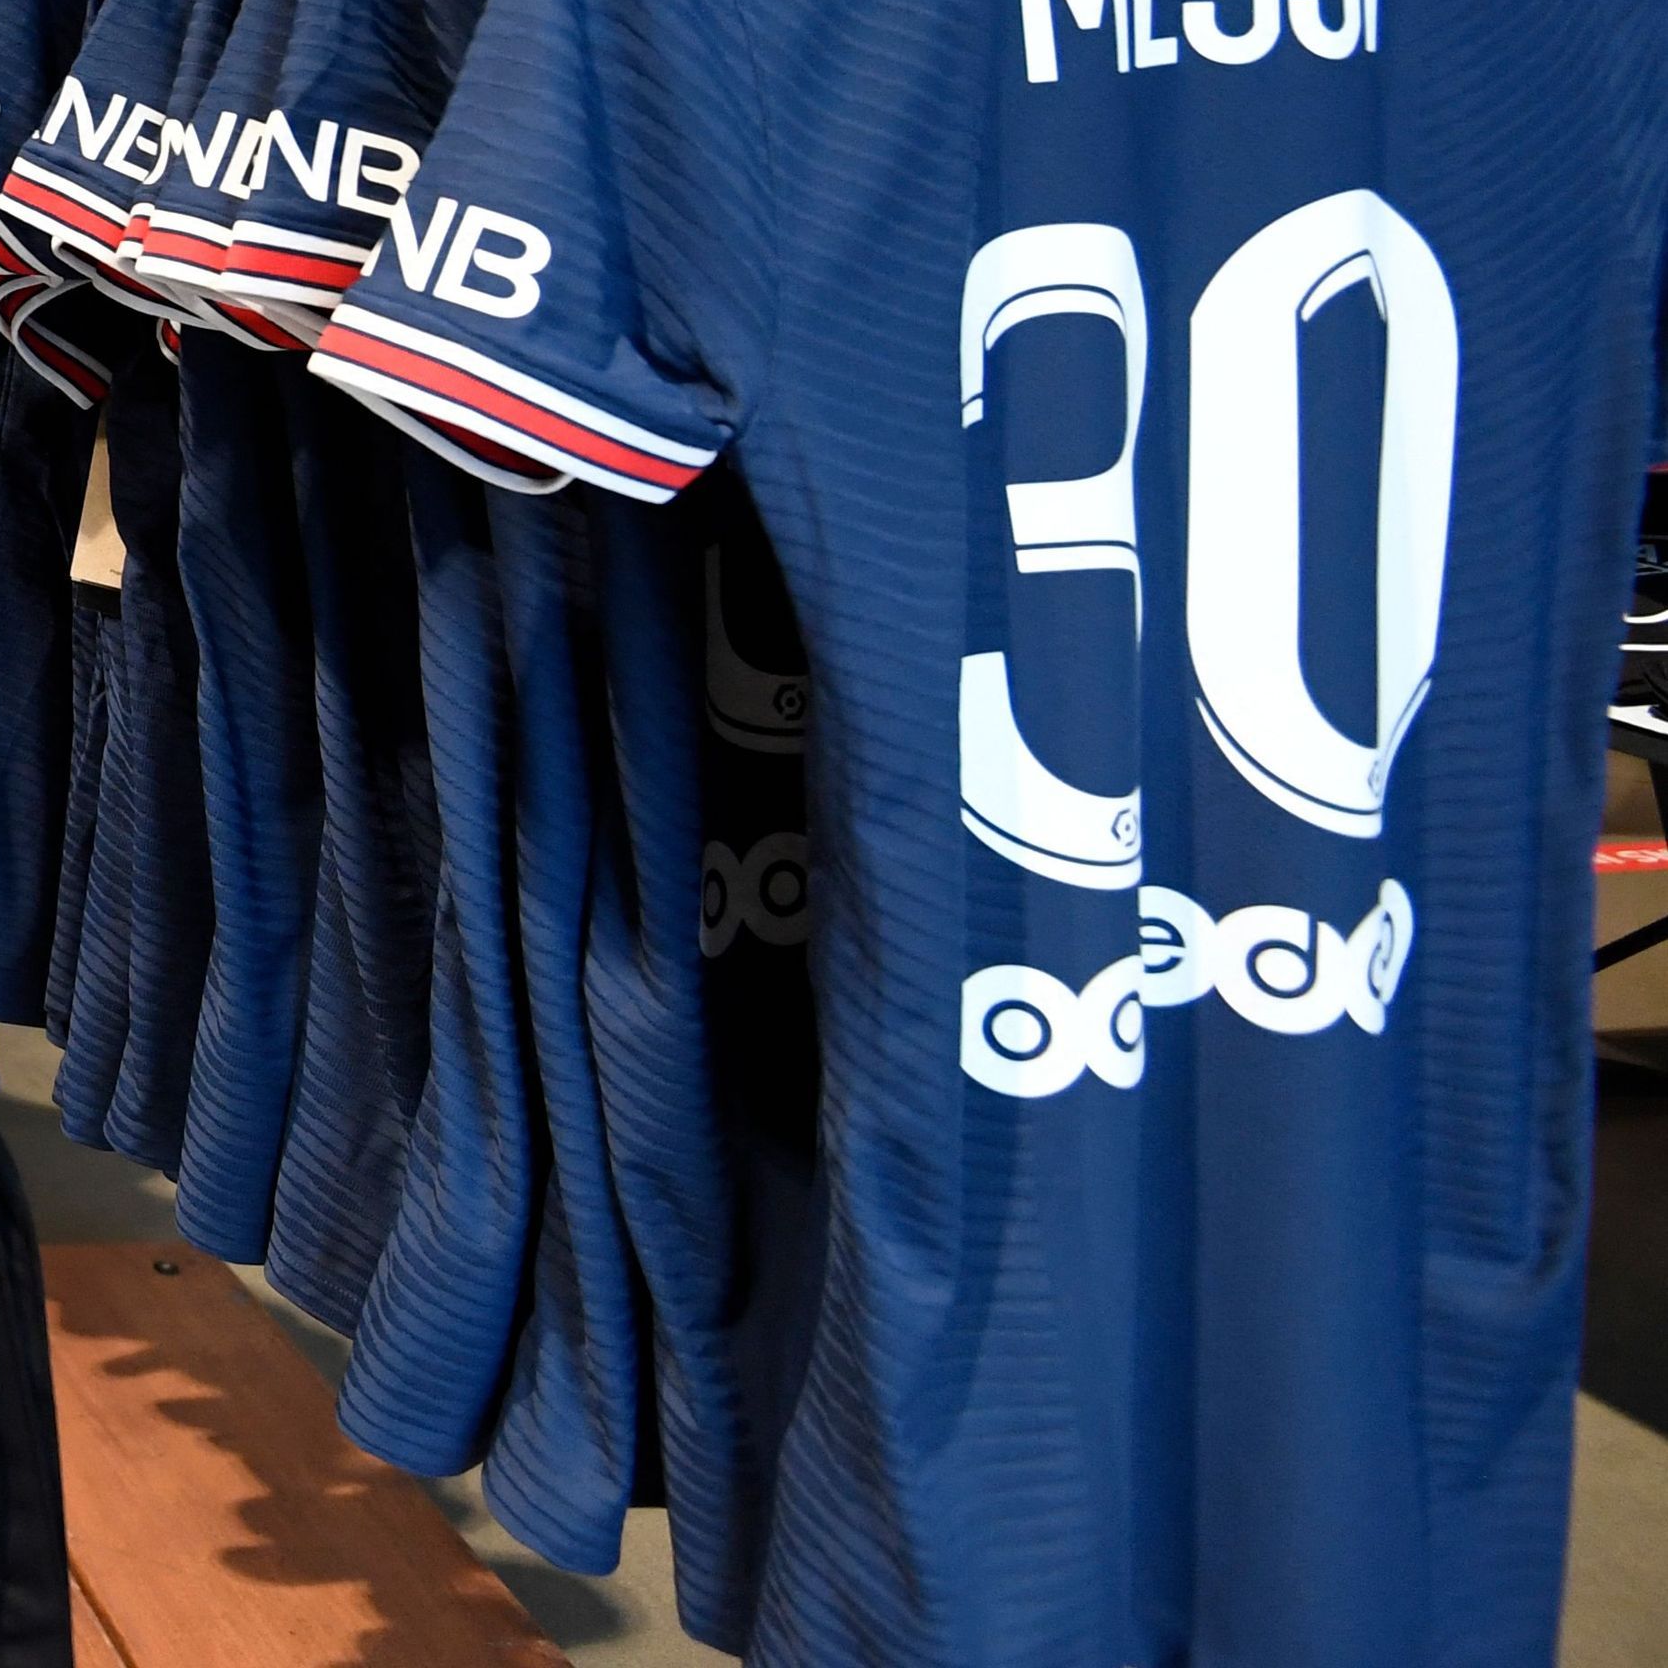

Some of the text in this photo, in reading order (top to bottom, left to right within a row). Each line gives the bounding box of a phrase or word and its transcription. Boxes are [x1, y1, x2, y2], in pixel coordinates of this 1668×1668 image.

[251, 109, 421, 218] NB
[362, 195, 553, 319] NB
[959, 189, 1459, 890] 30
